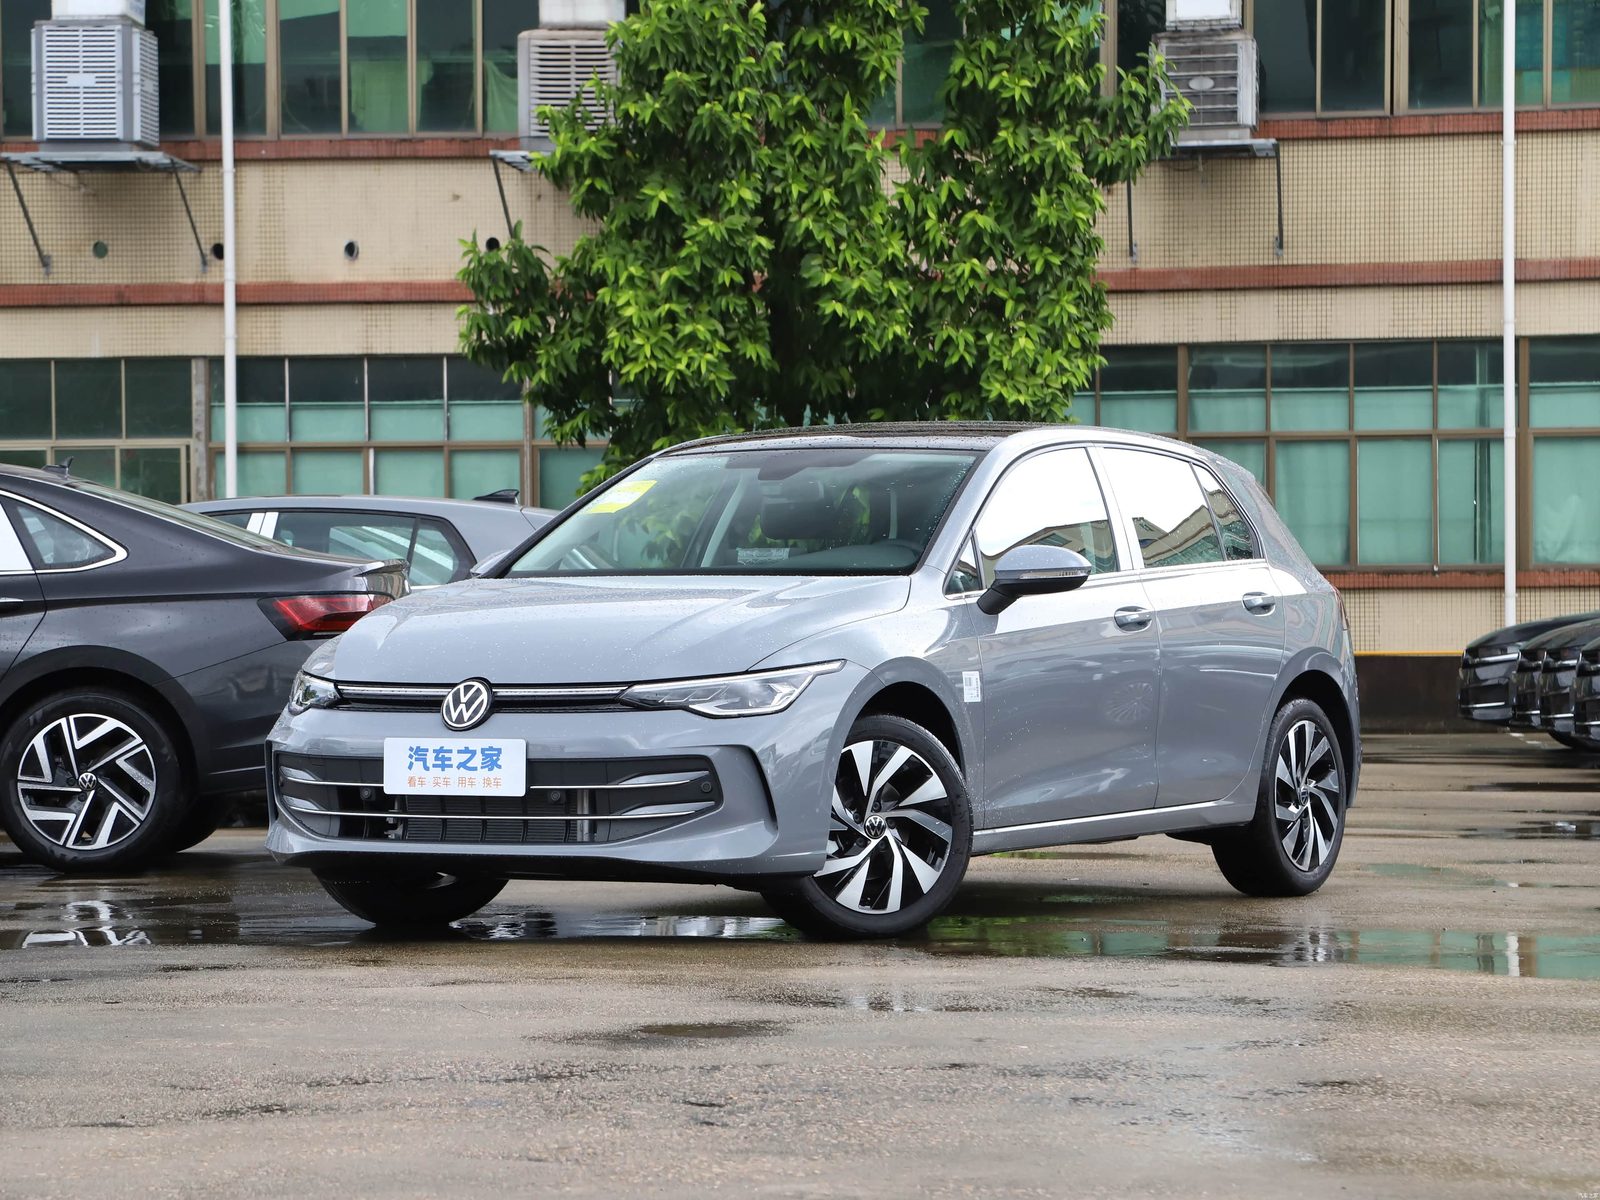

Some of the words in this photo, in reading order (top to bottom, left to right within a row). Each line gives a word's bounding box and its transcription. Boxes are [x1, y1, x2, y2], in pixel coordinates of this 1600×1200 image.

[445, 682, 489, 726] VW
[407, 745, 503, 772] 汽车之家
[407, 776, 427, 788] 看车
[432, 776, 451, 788] 买车
[457, 776, 477, 788] 用车
[865, 815, 886, 838] VW
